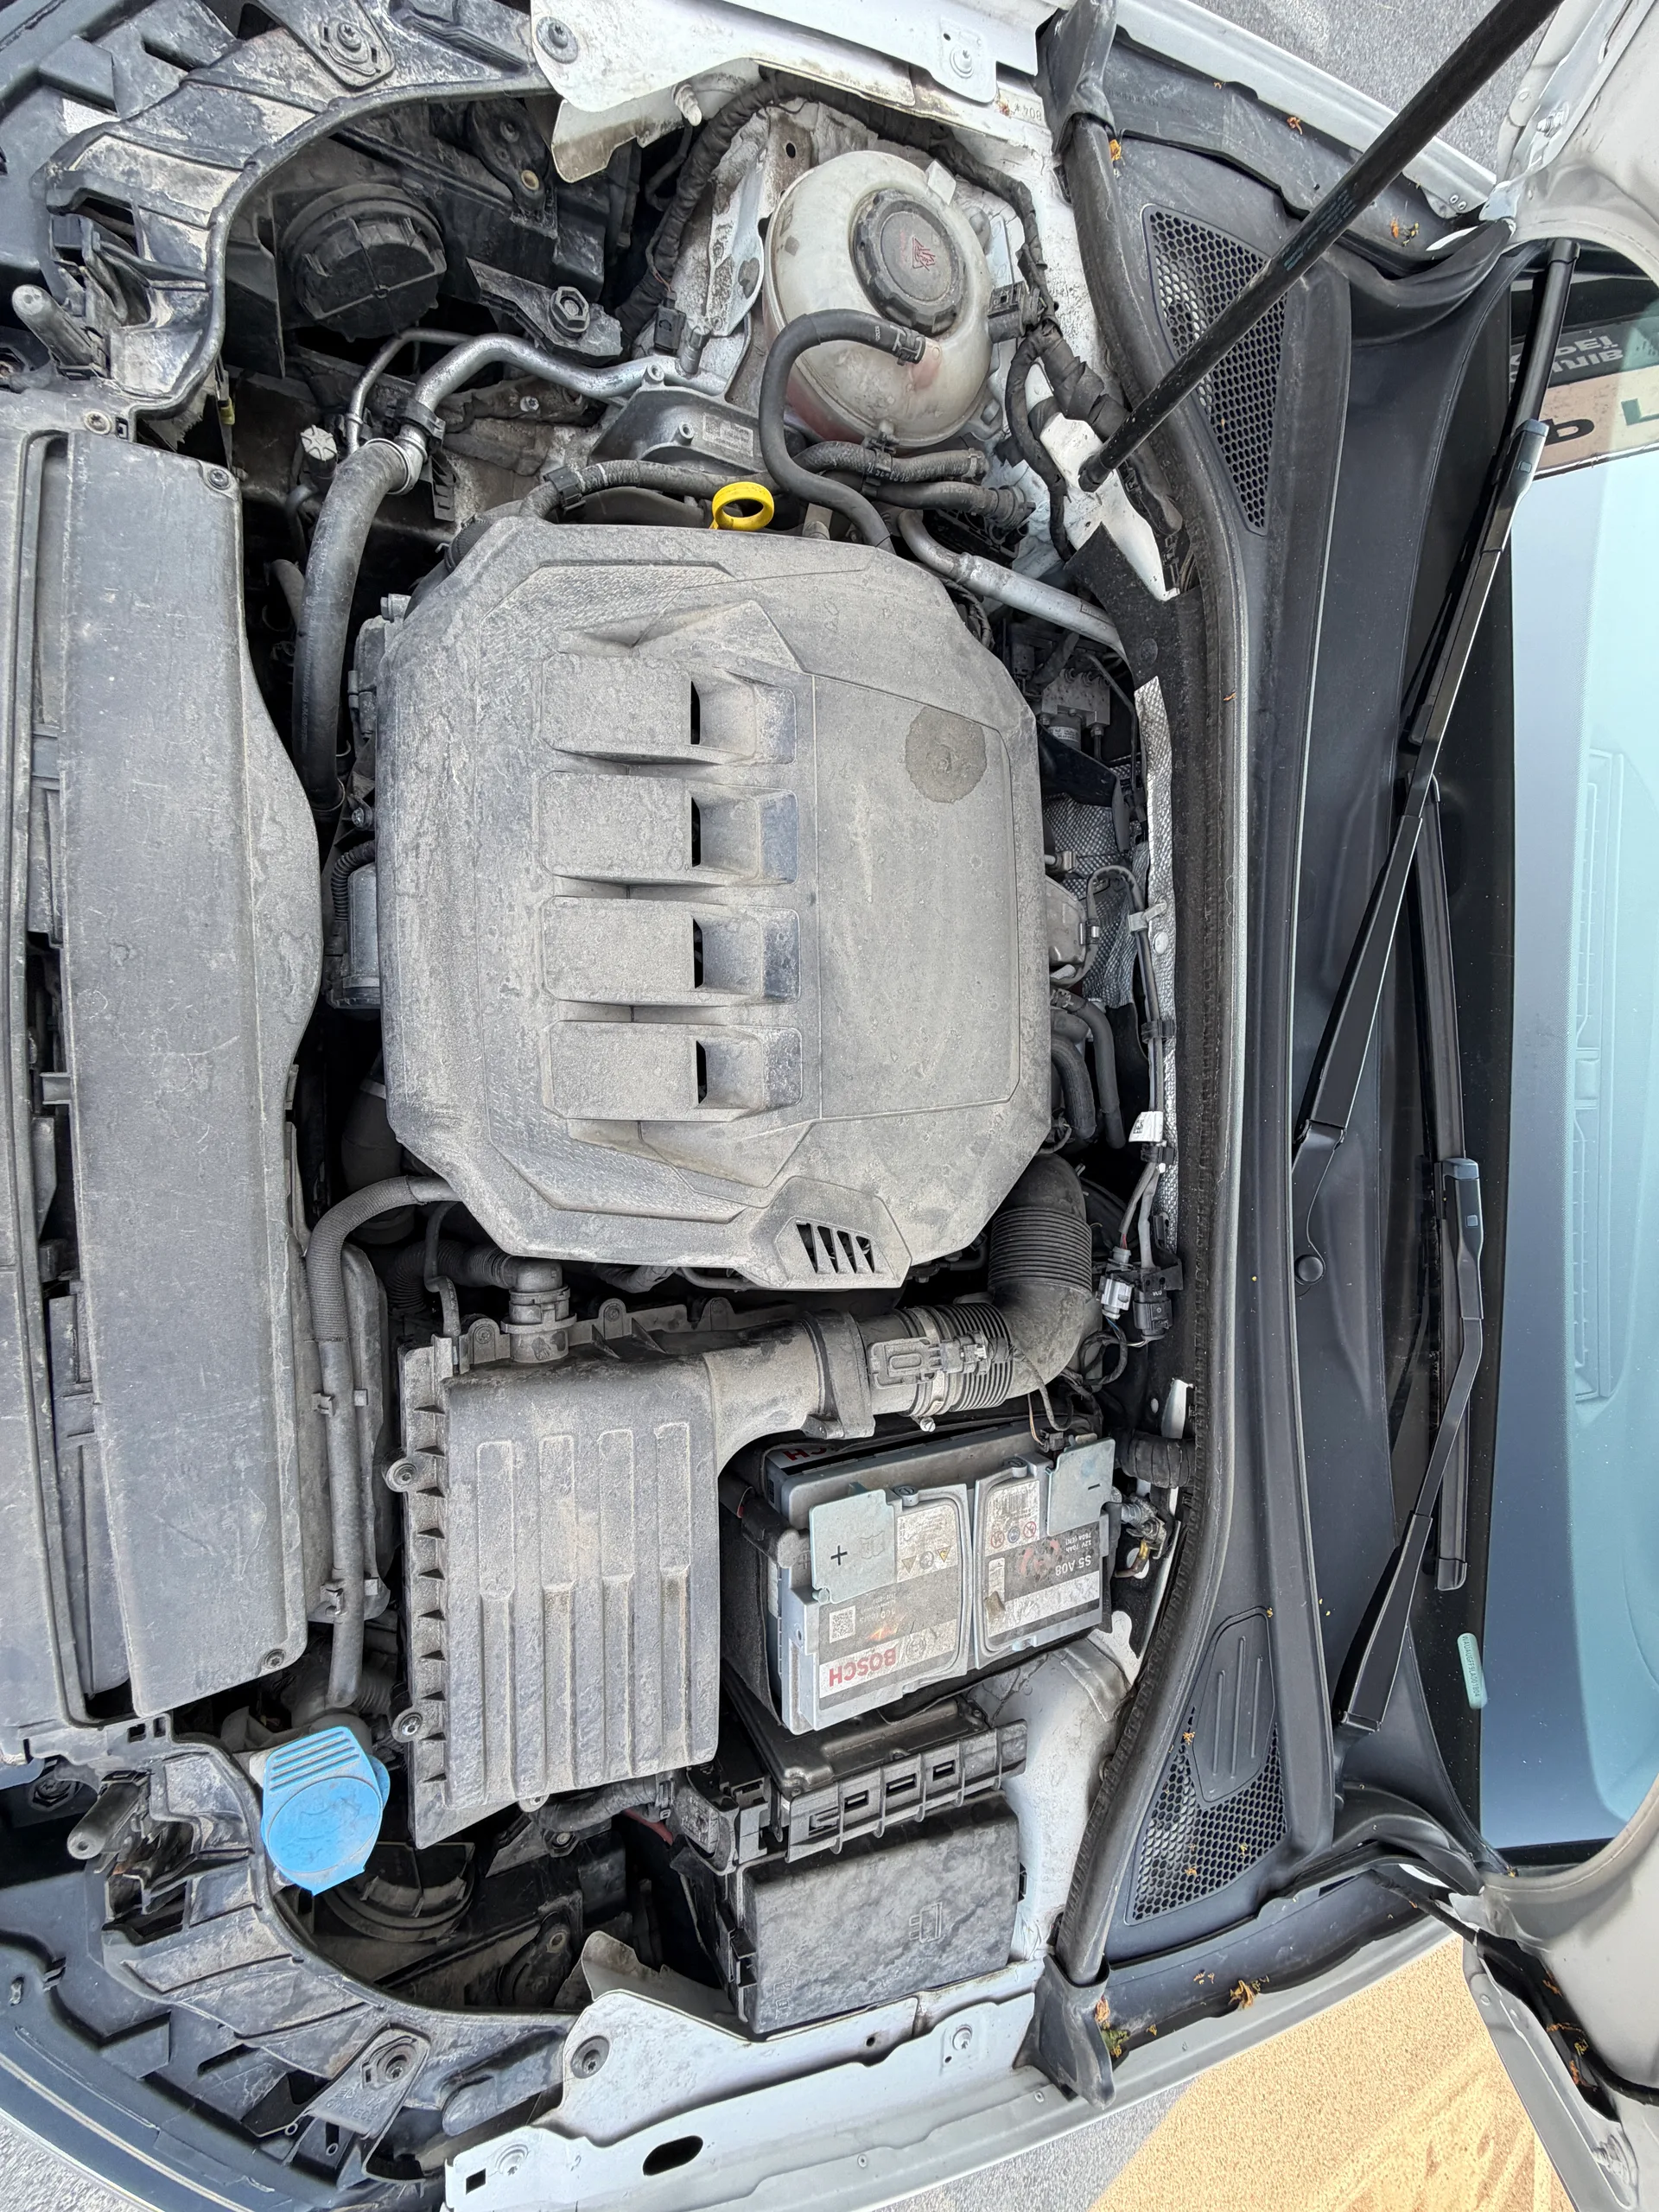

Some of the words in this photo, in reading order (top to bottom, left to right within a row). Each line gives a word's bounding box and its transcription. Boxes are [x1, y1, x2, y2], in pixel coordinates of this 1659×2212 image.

[1055, 1560, 1076, 1576] A08
[1078, 1555, 1091, 1568] S5
[830, 1647, 897, 1688] BOSCH
